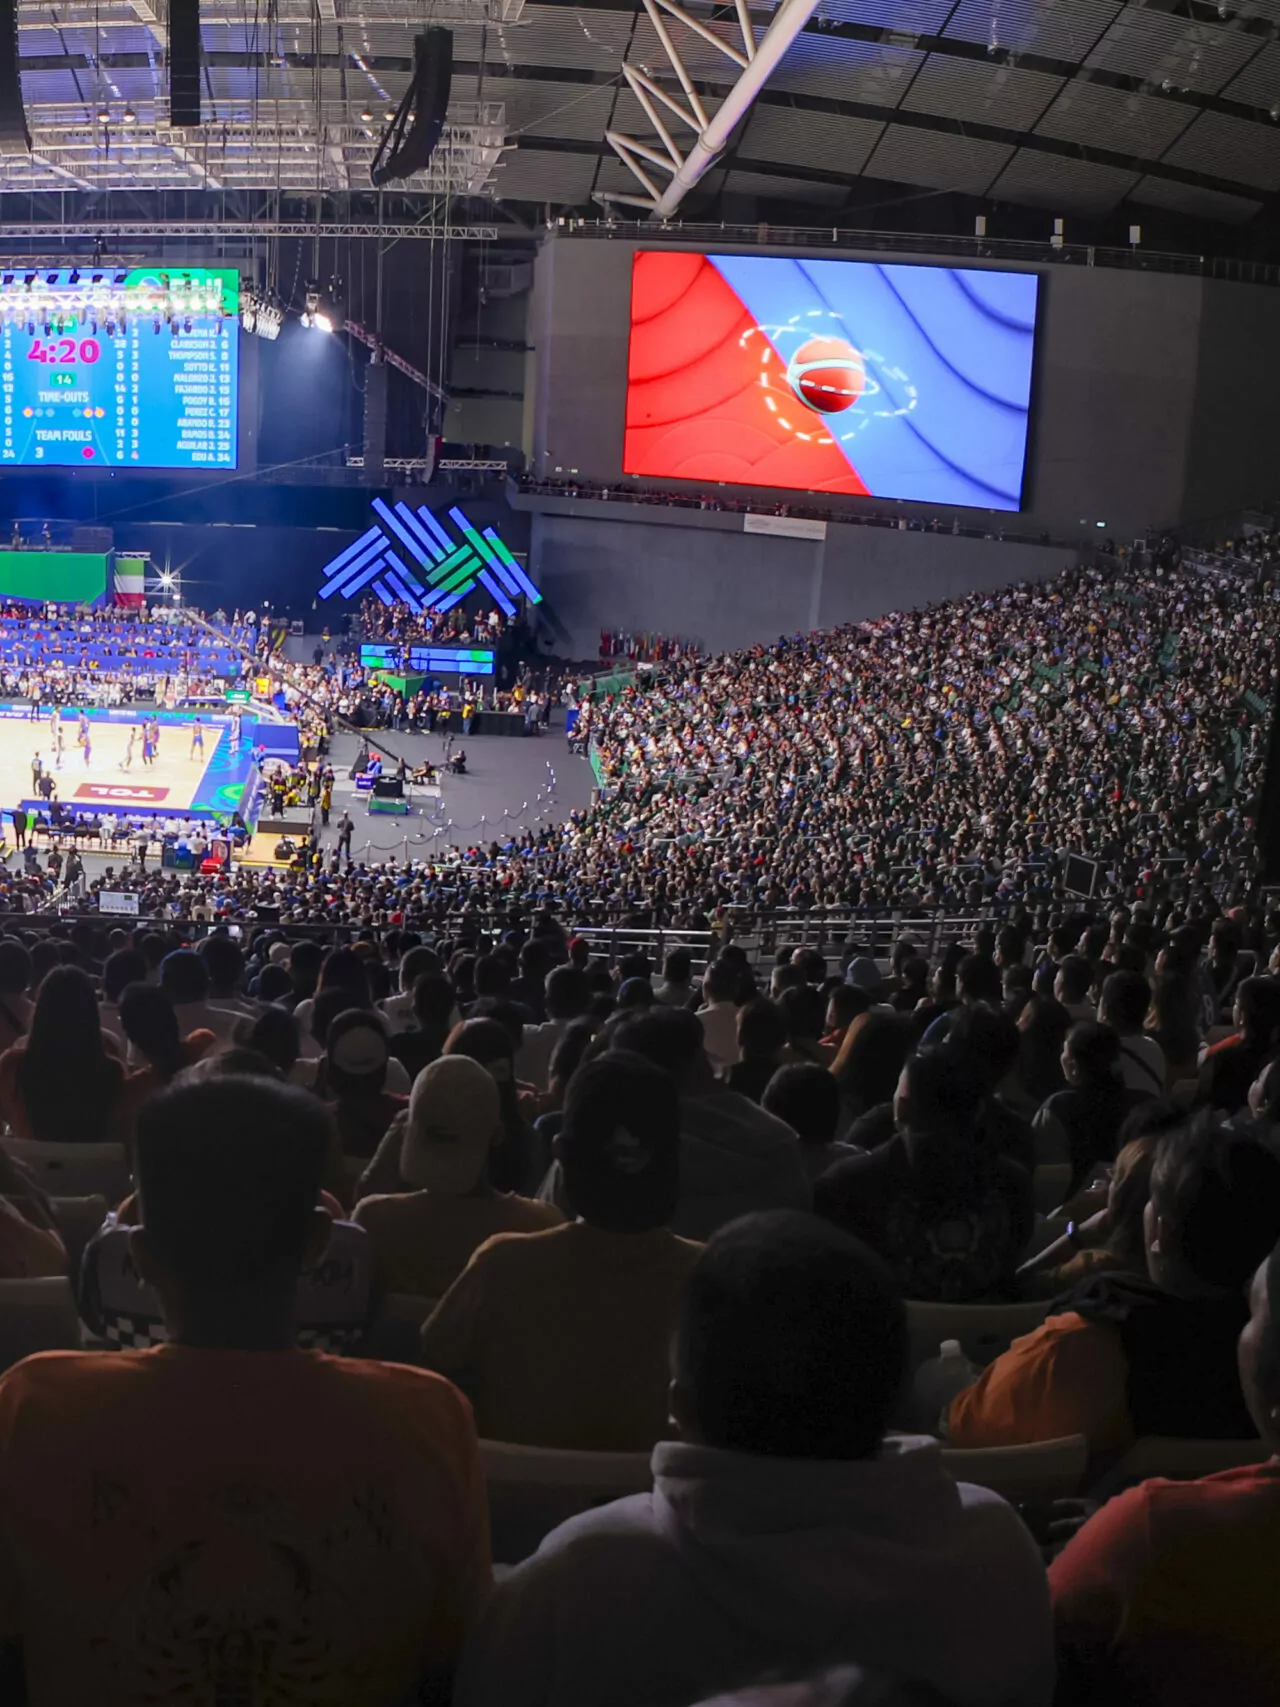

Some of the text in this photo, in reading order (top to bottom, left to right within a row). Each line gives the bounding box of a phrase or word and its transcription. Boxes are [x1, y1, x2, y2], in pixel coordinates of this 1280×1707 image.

[27, 338, 100, 364] 4:20
[57, 375, 72, 384] 14
[39, 392, 88, 402] TIME-OUTS
[36, 430, 92, 441] TEAM FOULS
[35, 447, 44, 458] 3
[90, 786, 154, 798] TCL
